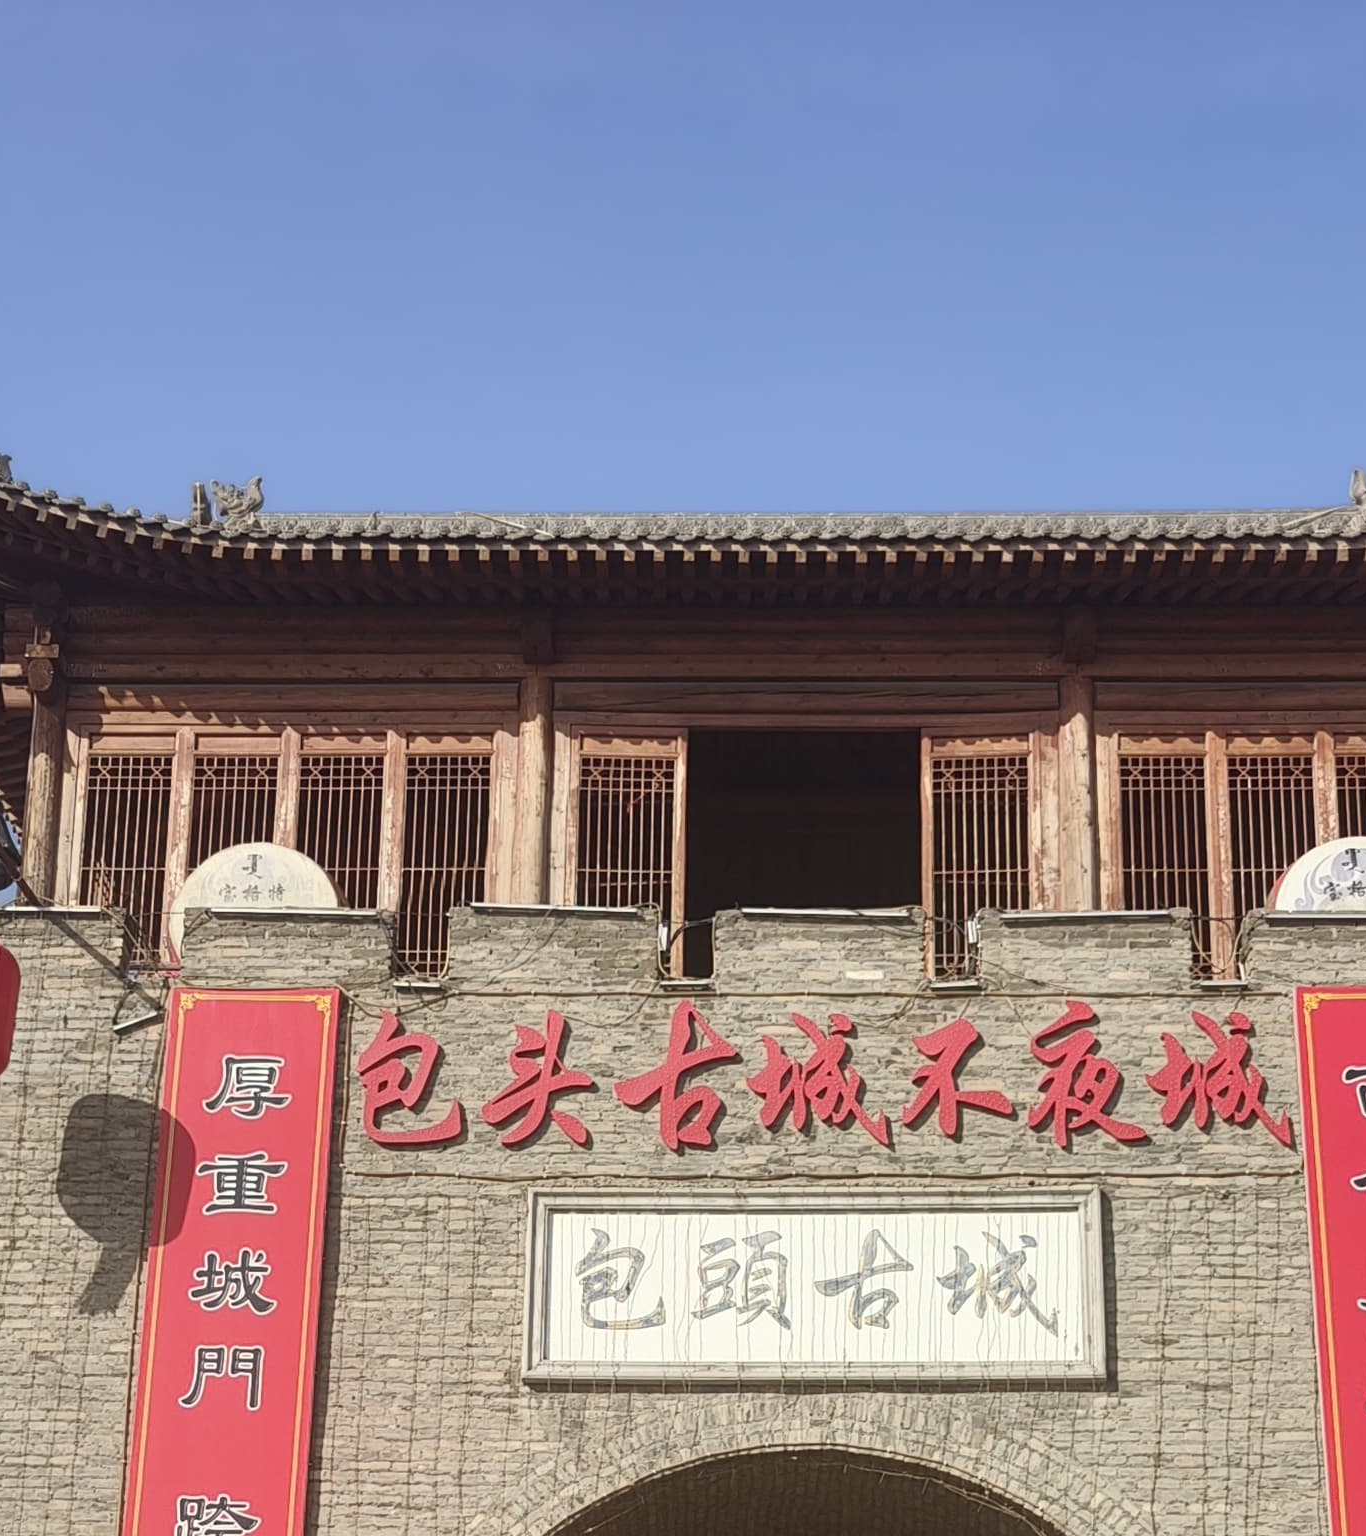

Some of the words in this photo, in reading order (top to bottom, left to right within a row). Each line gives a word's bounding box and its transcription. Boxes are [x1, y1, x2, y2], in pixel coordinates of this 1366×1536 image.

[357, 999, 1293, 1152] 包头古城不夜城
[573, 1227, 1062, 1332] 包頭古城
